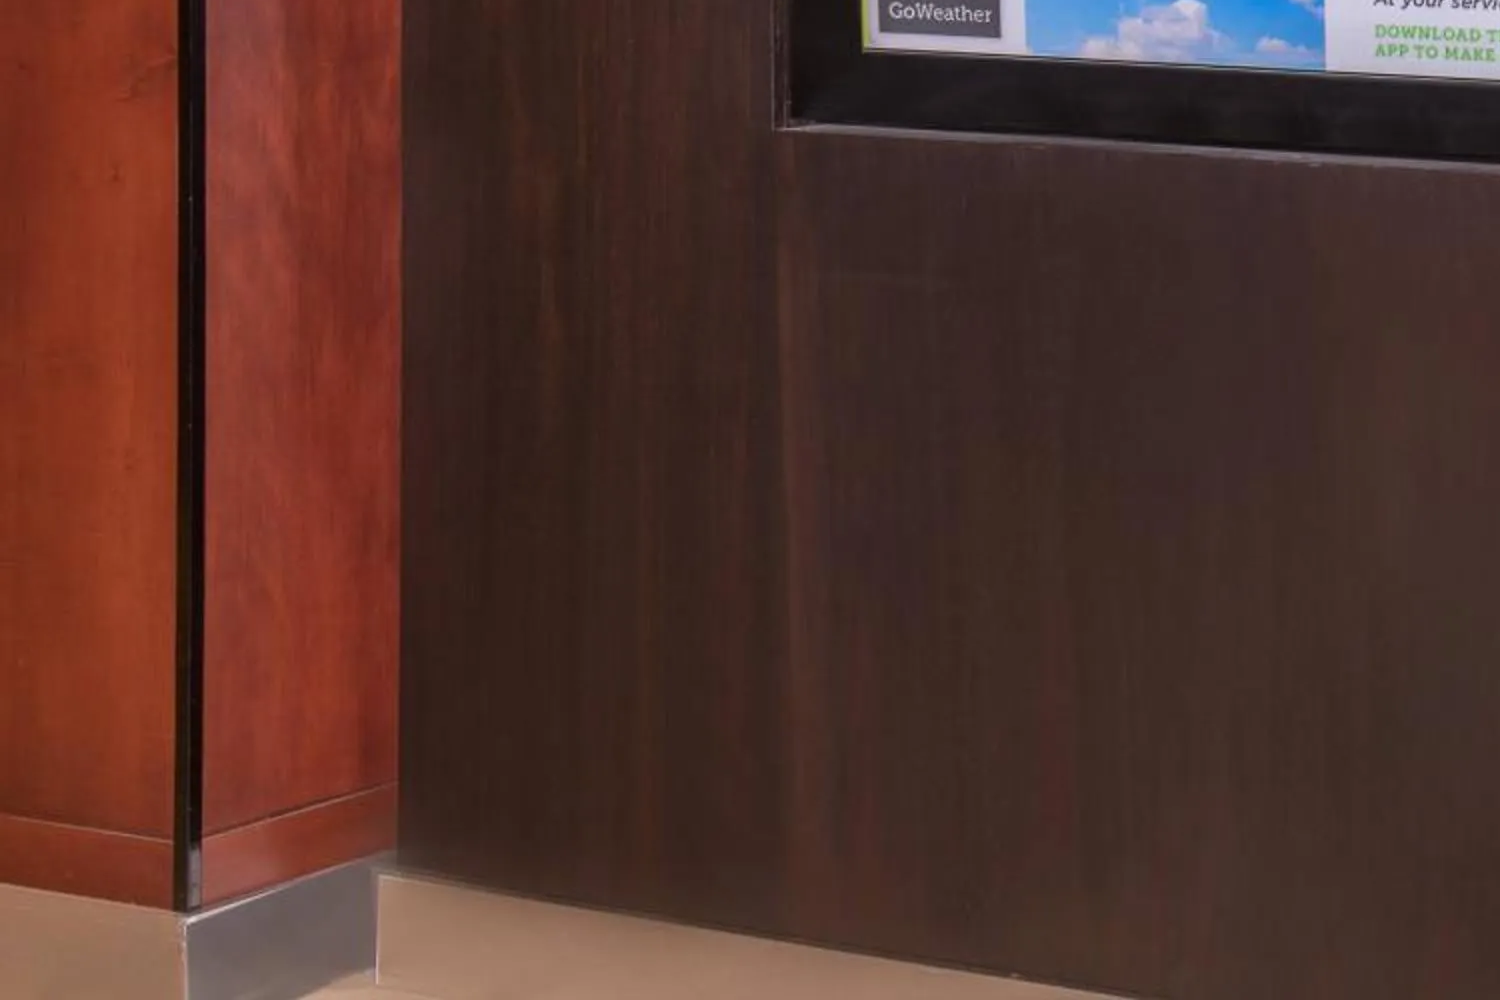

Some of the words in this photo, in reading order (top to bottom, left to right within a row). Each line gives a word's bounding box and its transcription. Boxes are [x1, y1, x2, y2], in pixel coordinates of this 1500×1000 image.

[889, 1, 992, 23] GoWeather
[1374, 24, 1481, 43] DOWNLOAD
[1375, 43, 1407, 58] APP
[1414, 45, 1439, 60] TO
[1445, 46, 1496, 62] MAKE
